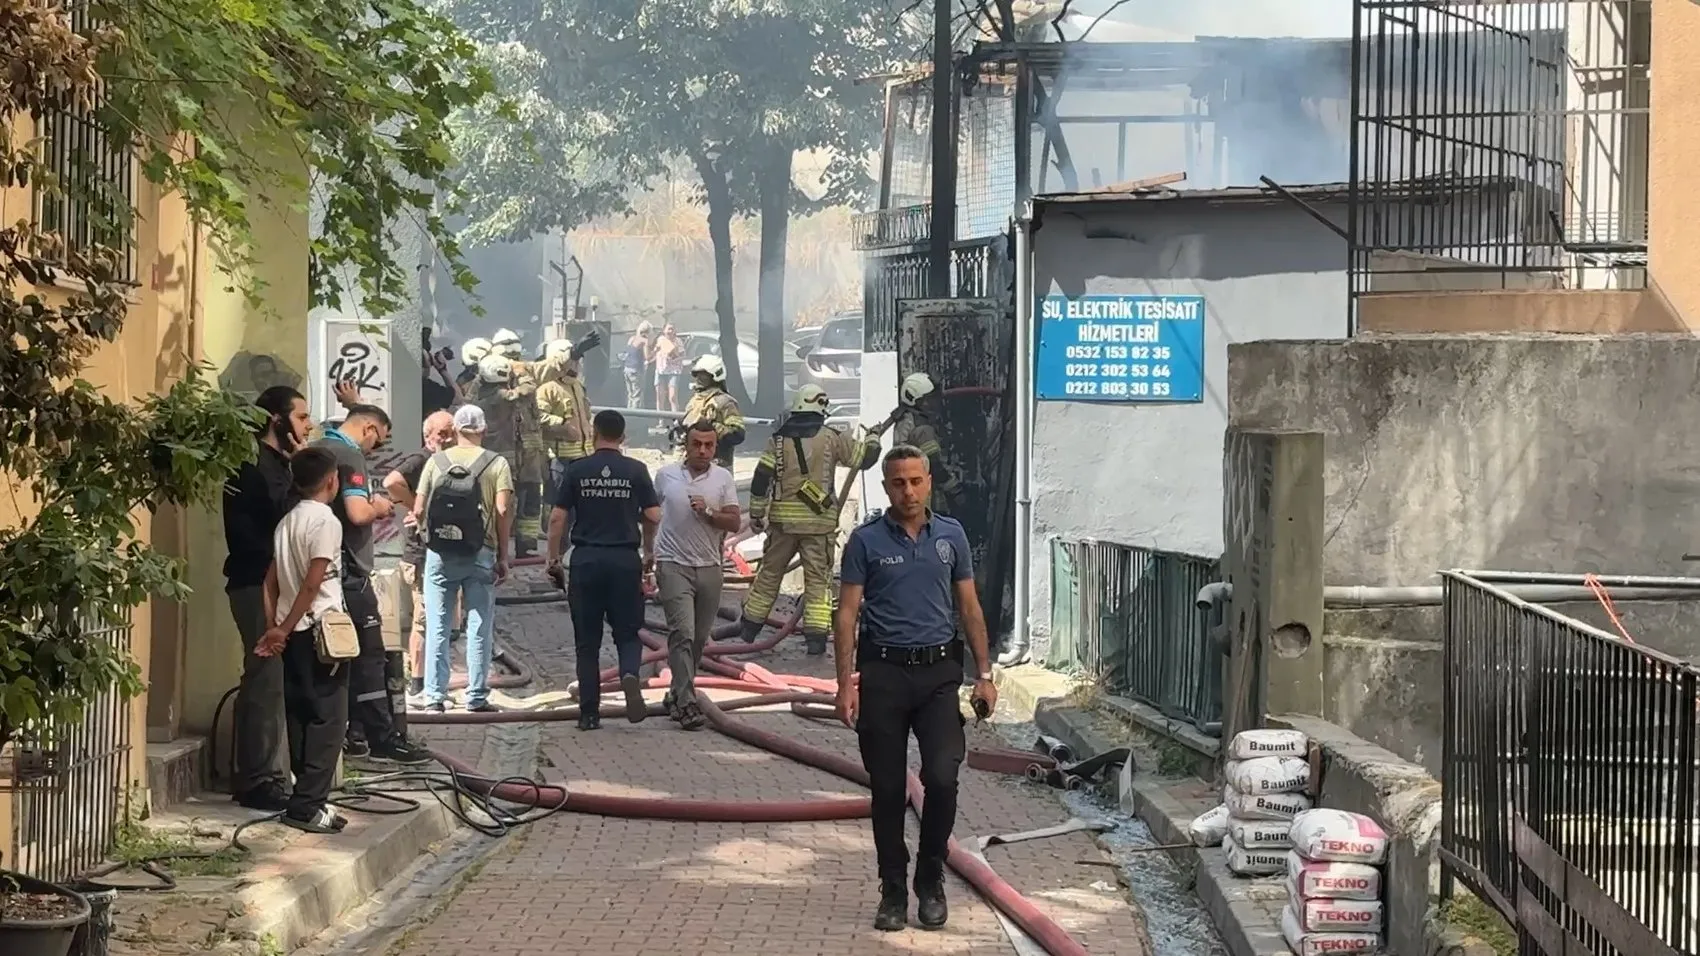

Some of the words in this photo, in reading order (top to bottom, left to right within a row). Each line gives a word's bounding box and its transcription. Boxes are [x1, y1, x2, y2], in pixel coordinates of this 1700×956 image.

[1042, 300, 1064, 322] SU,
[1067, 297, 1133, 319] ELEKTRİK
[1136, 297, 1197, 320] TESİSATI
[1078, 320, 1159, 342] HİZMETLERİ
[1066, 345, 1101, 359] 0532
[1104, 346, 1128, 359] 153
[1152, 346, 1170, 359] 35
[1065, 363, 1098, 377] 0212
[1101, 364, 1128, 377] 302
[1131, 364, 1149, 377] 53
[1152, 364, 1171, 377] 64
[1065, 381, 1098, 394] 0212
[1101, 381, 1127, 394] 803
[1130, 382, 1149, 395] 30
[1152, 382, 1170, 395] 53
[1249, 740, 1296, 751] Baumit
[1261, 774, 1306, 790] Baumit
[1254, 831, 1289, 841] Baum
[1320, 840, 1374, 854] TEKNO
[1245, 854, 1288, 866] aumit
[1312, 877, 1369, 889] TEKNO
[1316, 910, 1372, 921] TEKNO
[1311, 938, 1367, 950] TEKNO
